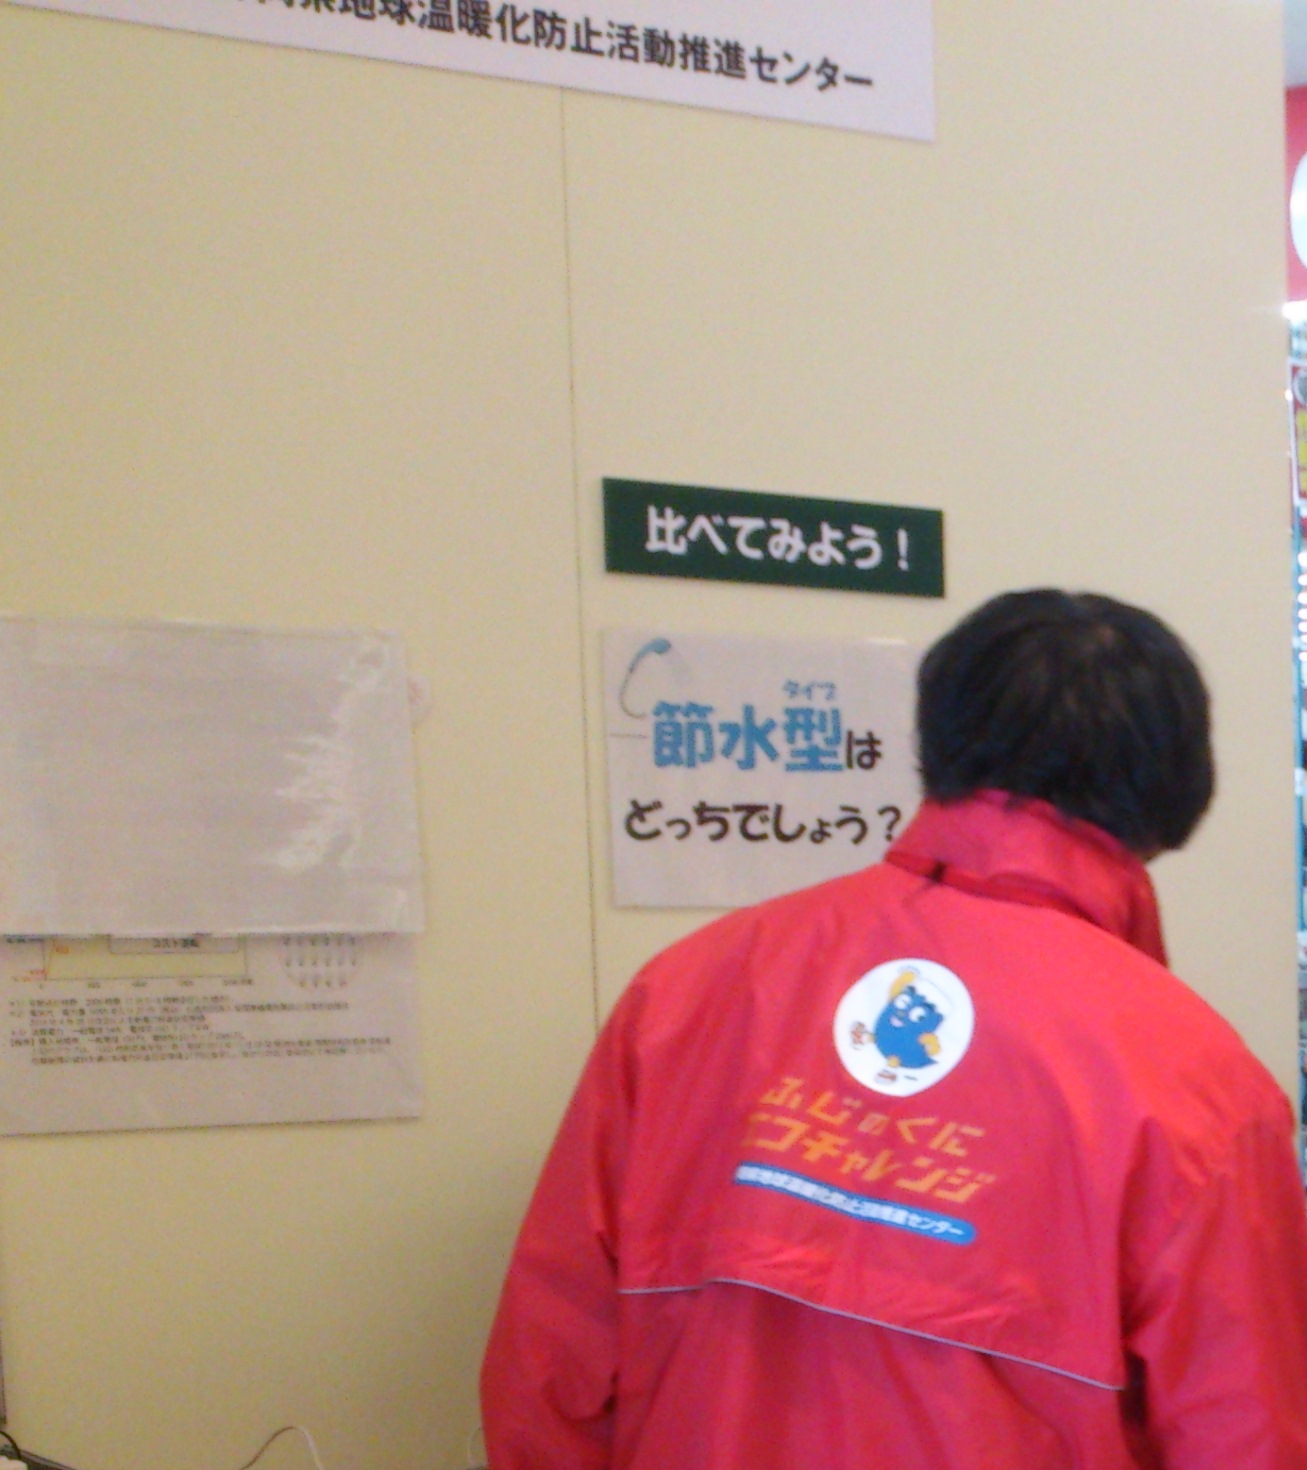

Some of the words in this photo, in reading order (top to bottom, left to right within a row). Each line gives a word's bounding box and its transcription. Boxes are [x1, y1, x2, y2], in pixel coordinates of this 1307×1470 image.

[645, 505, 910, 571] 比べてみよう！
[652, 701, 883, 773] 節水型は
[624, 798, 902, 845] どっちでしょう？
